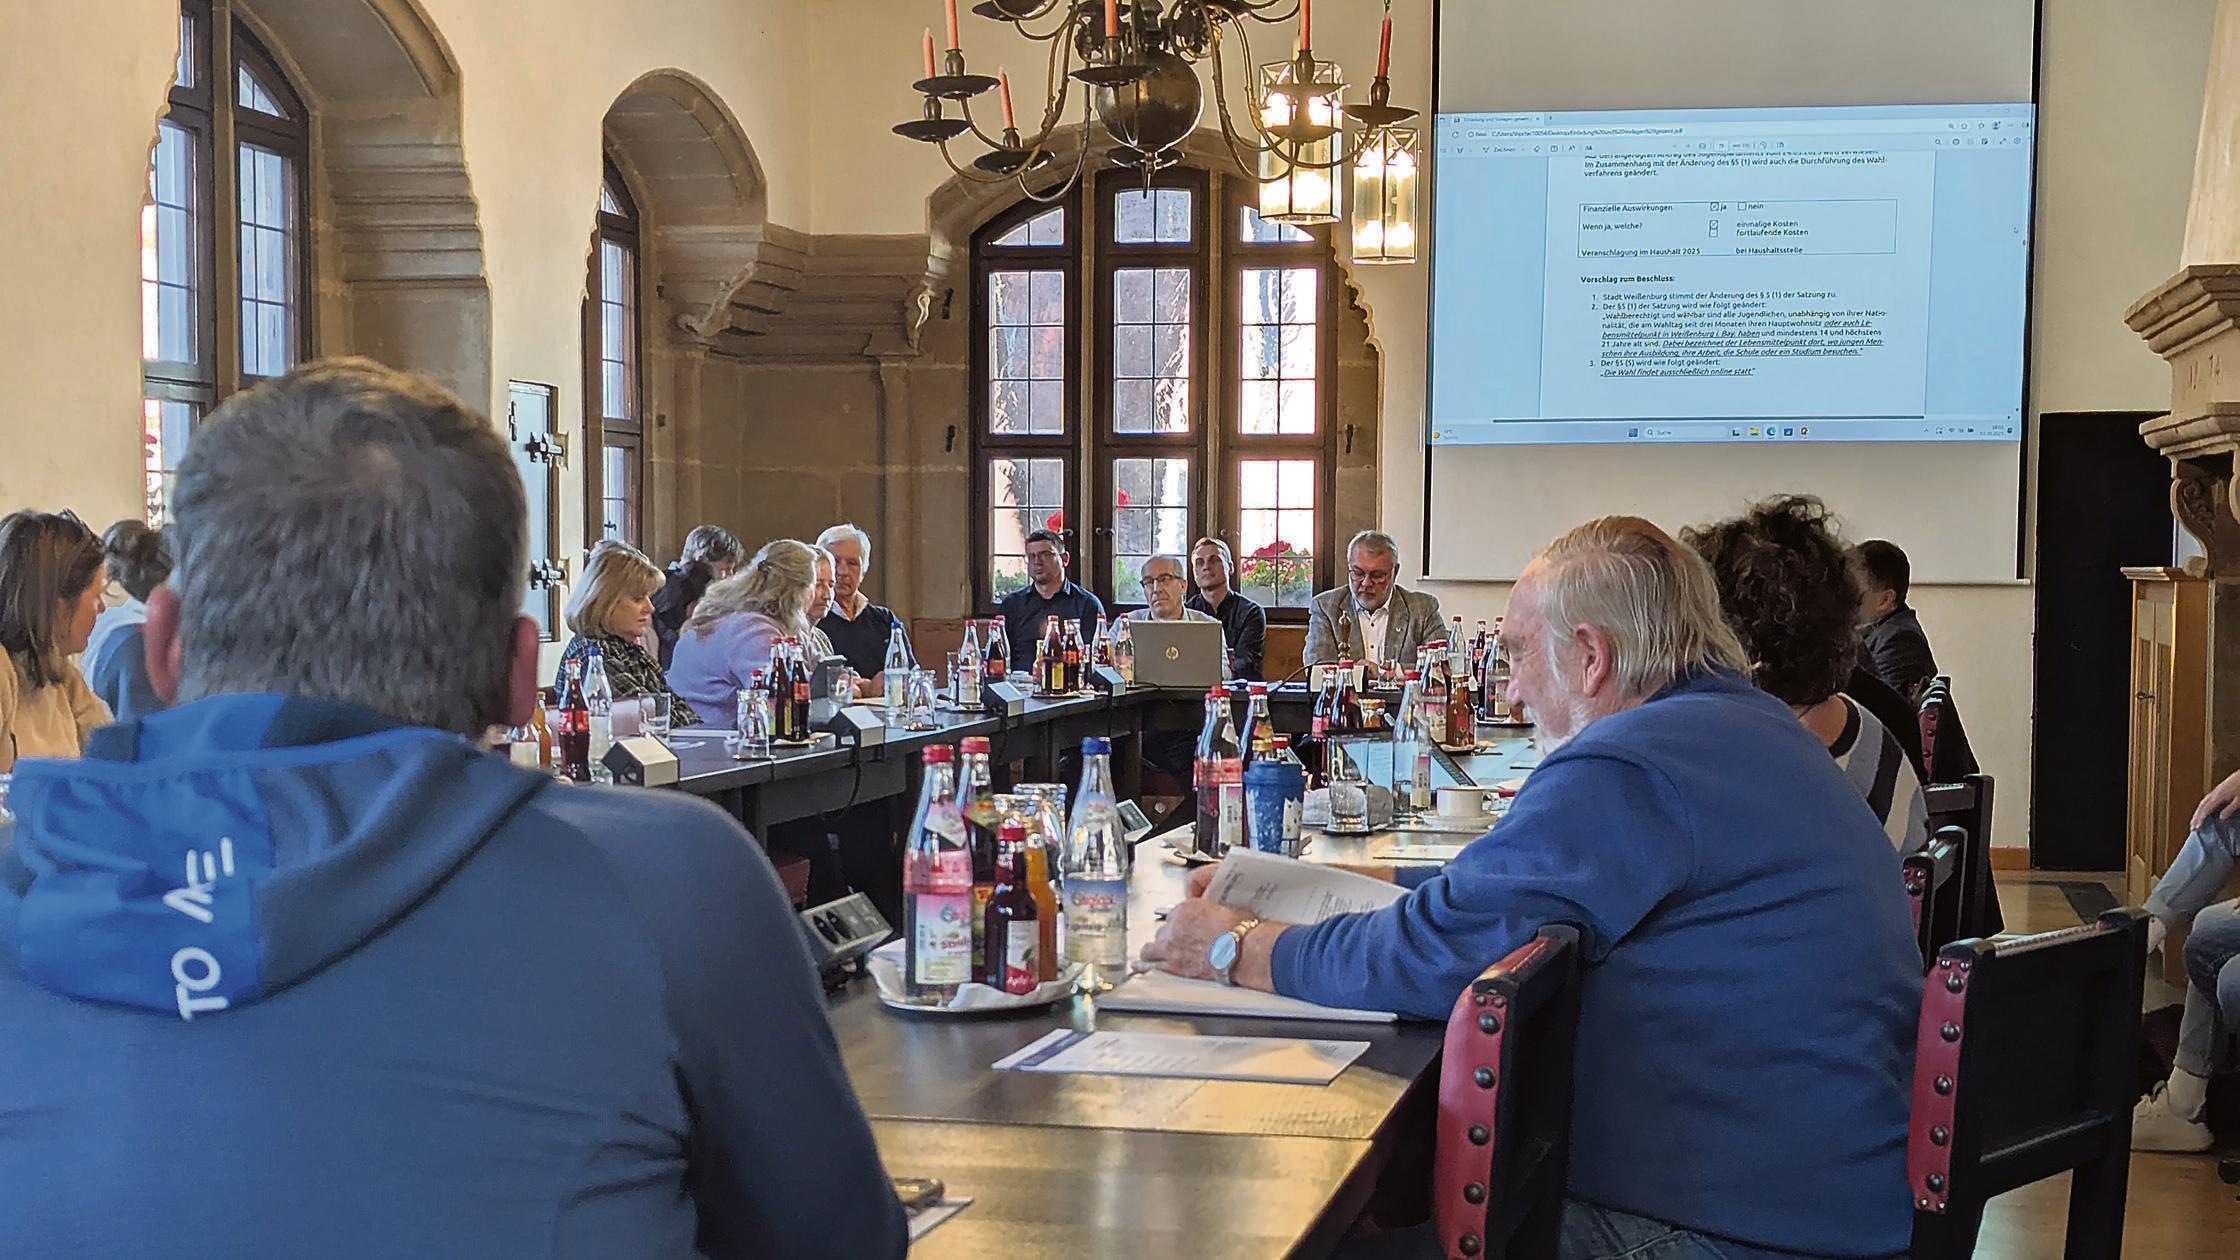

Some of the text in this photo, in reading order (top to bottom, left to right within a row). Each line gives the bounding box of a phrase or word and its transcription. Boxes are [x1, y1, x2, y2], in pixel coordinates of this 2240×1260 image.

[1595, 160, 1652, 168] Zusammenhang
[1680, 158, 1716, 167] Änderung
[1741, 158, 1750, 166] (1)
[1800, 156, 1850, 166] Durchführung
[1622, 204, 1673, 212] Auswirkungen
[1582, 222, 1603, 230] Wenn
[1615, 222, 1642, 230] welche?
[1736, 220, 1772, 229] einmalige
[1581, 249, 1638, 258] Veranschlagung
[1650, 248, 1680, 256] Haushalt
[1748, 246, 1802, 254] Haushaltsstelle
[1581, 276, 1618, 284] Vorschlag
[1636, 275, 1674, 283] Beschluss:
[1624, 292, 1668, 302] Weißenburg
[1710, 290, 1744, 300] Änderung
[1772, 290, 1782, 300] (1)
[1796, 290, 1826, 300] Satzung
[1627, 302, 1636, 310] (1)
[1652, 302, 1680, 310] Satzung
[1713, 300, 1730, 310] folgt
[1732, 300, 1766, 309] geändert:
[1737, 310, 1787, 319] Jugendlichen,
[1788, 310, 1830, 319] unabhängig
[1654, 321, 1682, 330] Wahltag
[1768, 320, 1821, 329] Hauptwohnsitz
[1602, 330, 1660, 339] bensmittelpunkt
[1671, 330, 1714, 339] Weißenburg
[1738, 330, 1760, 338] haben
[1684, 340, 1724, 348] bezeichnet
[1739, 339, 1806, 348] Lebensmittelpunkt
[1839, 339, 1864, 347] jungen
[1667, 358, 1685, 368] folgt
[1637, 368, 1659, 377] findet
[171, 946, 228, 1021] TO
